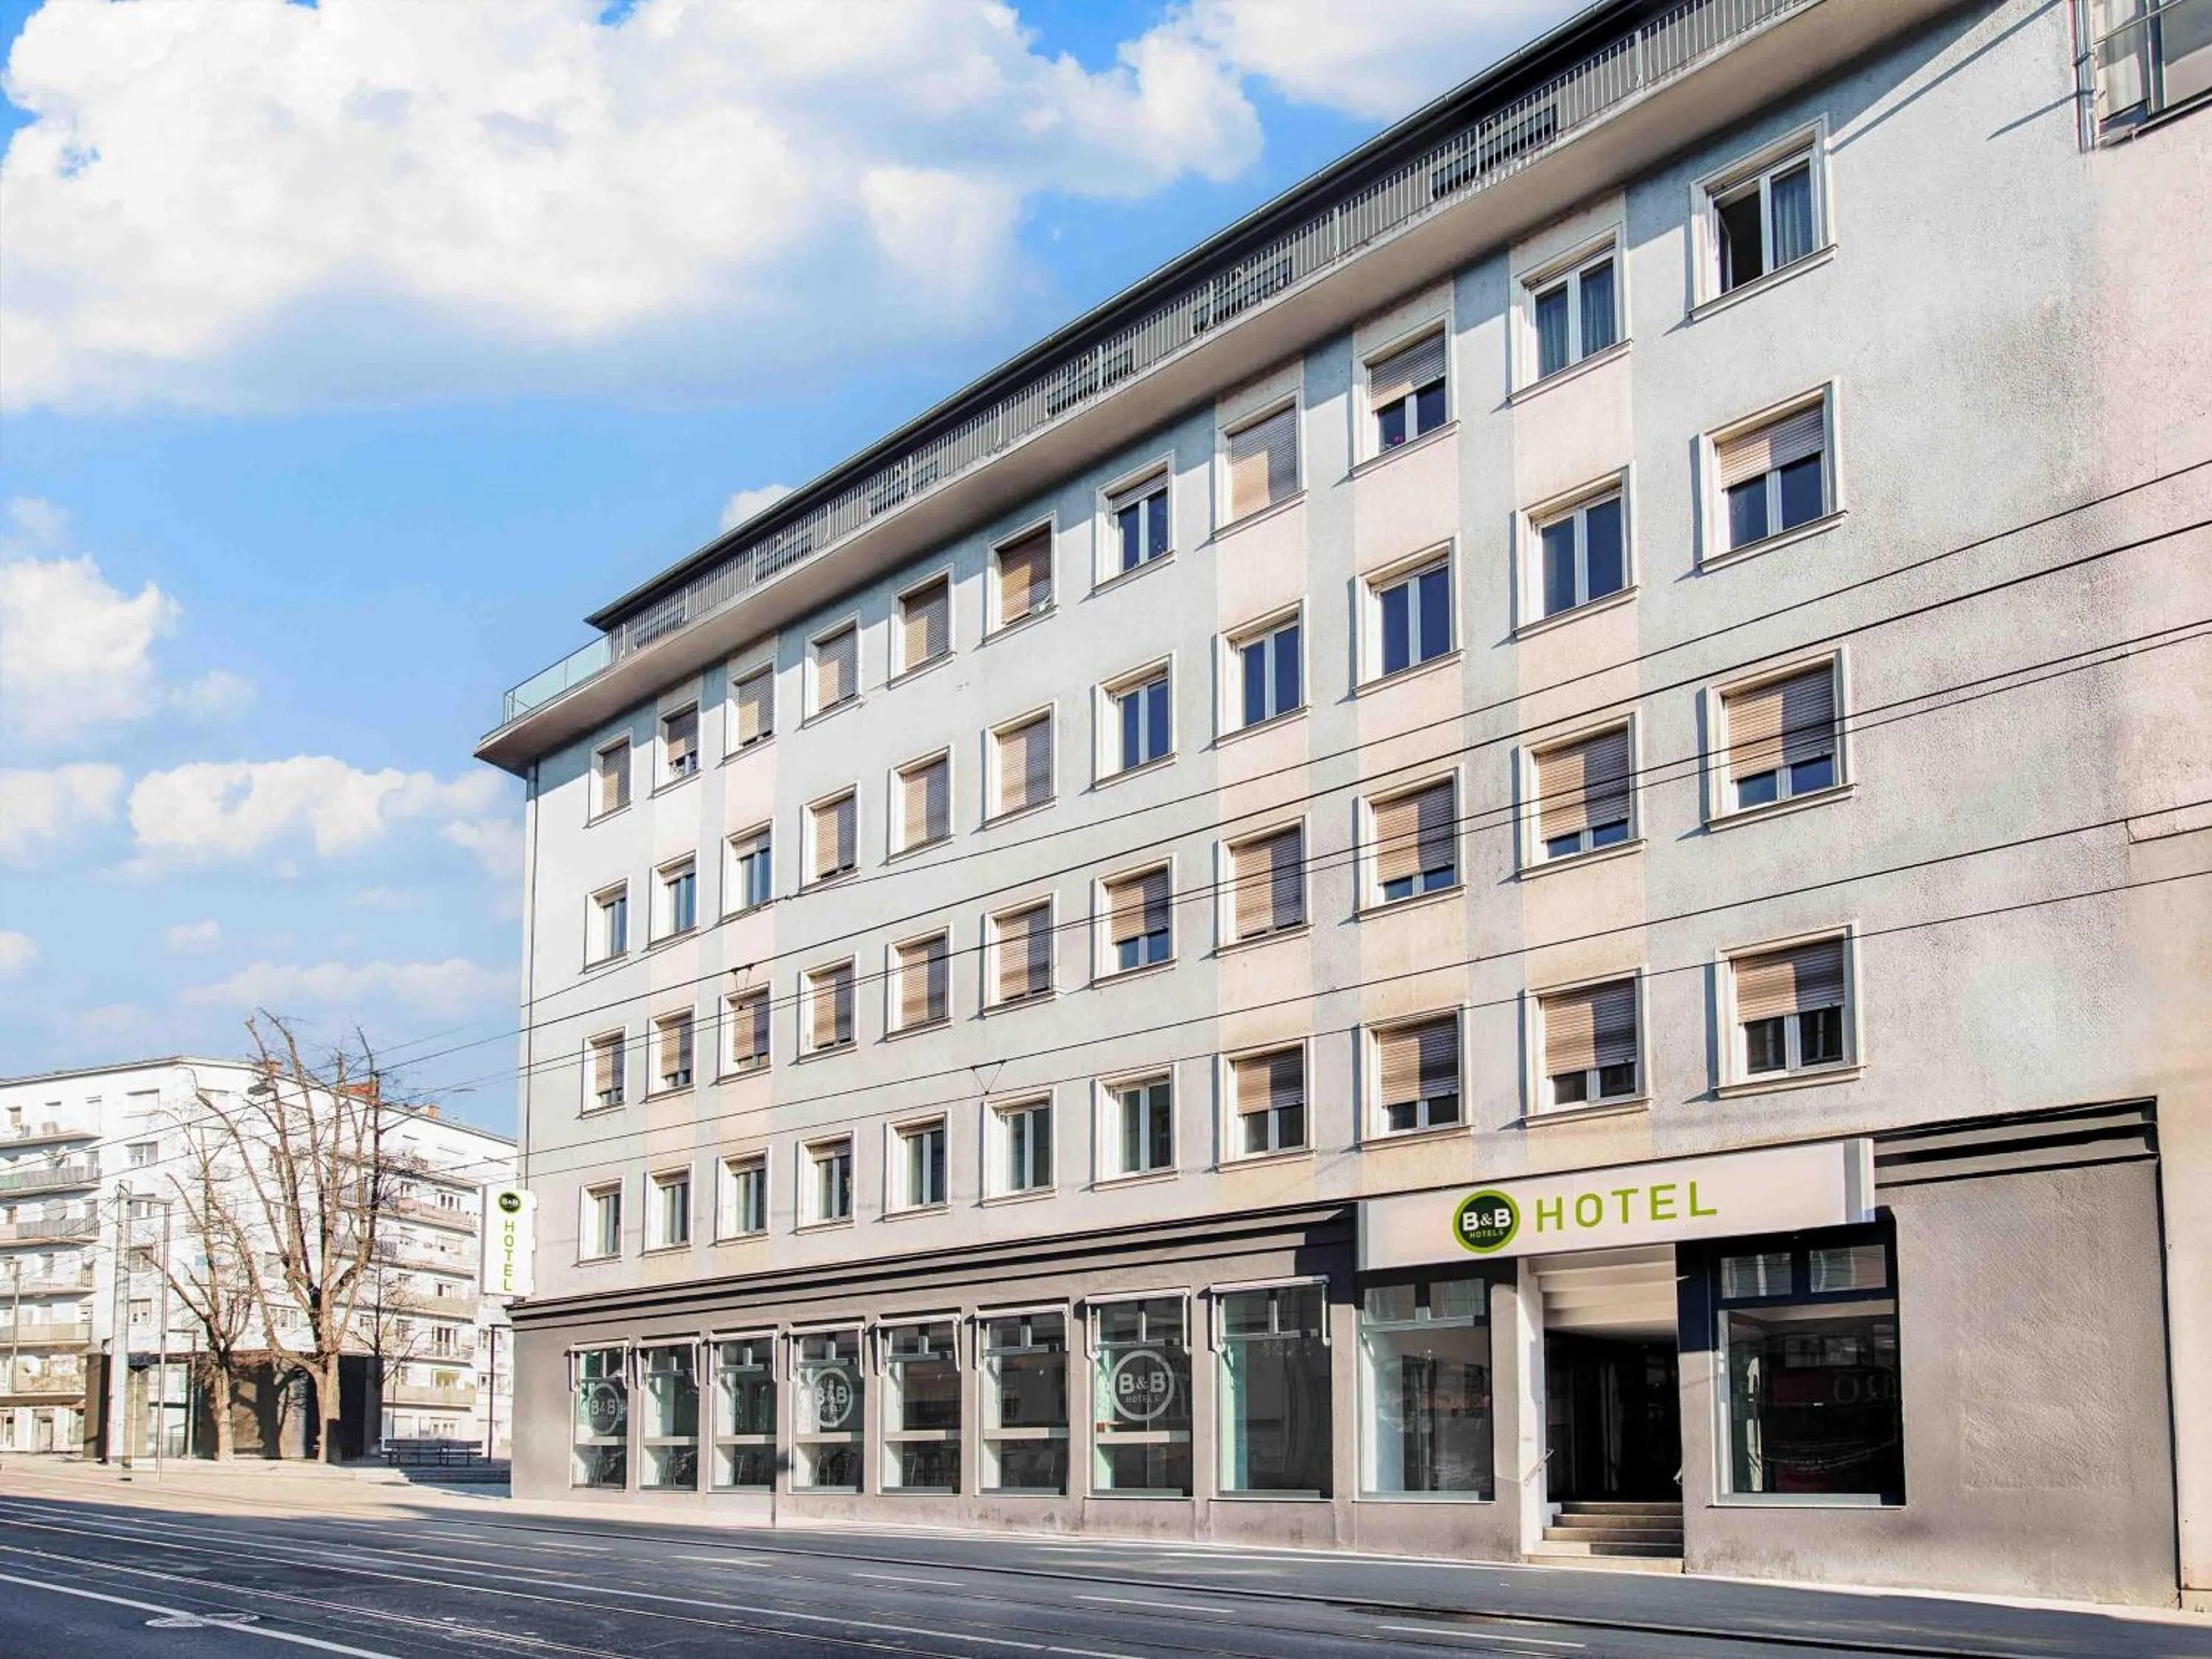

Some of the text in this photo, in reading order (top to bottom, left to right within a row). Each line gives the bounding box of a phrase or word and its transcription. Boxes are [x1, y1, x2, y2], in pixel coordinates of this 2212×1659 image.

[1536, 1181, 1717, 1232] HOTEL
[1462, 1208, 1512, 1231] B&B
[1470, 1228, 1504, 1239] HOTELS
[504, 1220, 515, 1291] HOTEL
[1119, 1371, 1166, 1394] B&B
[591, 1399, 616, 1415] B&B
